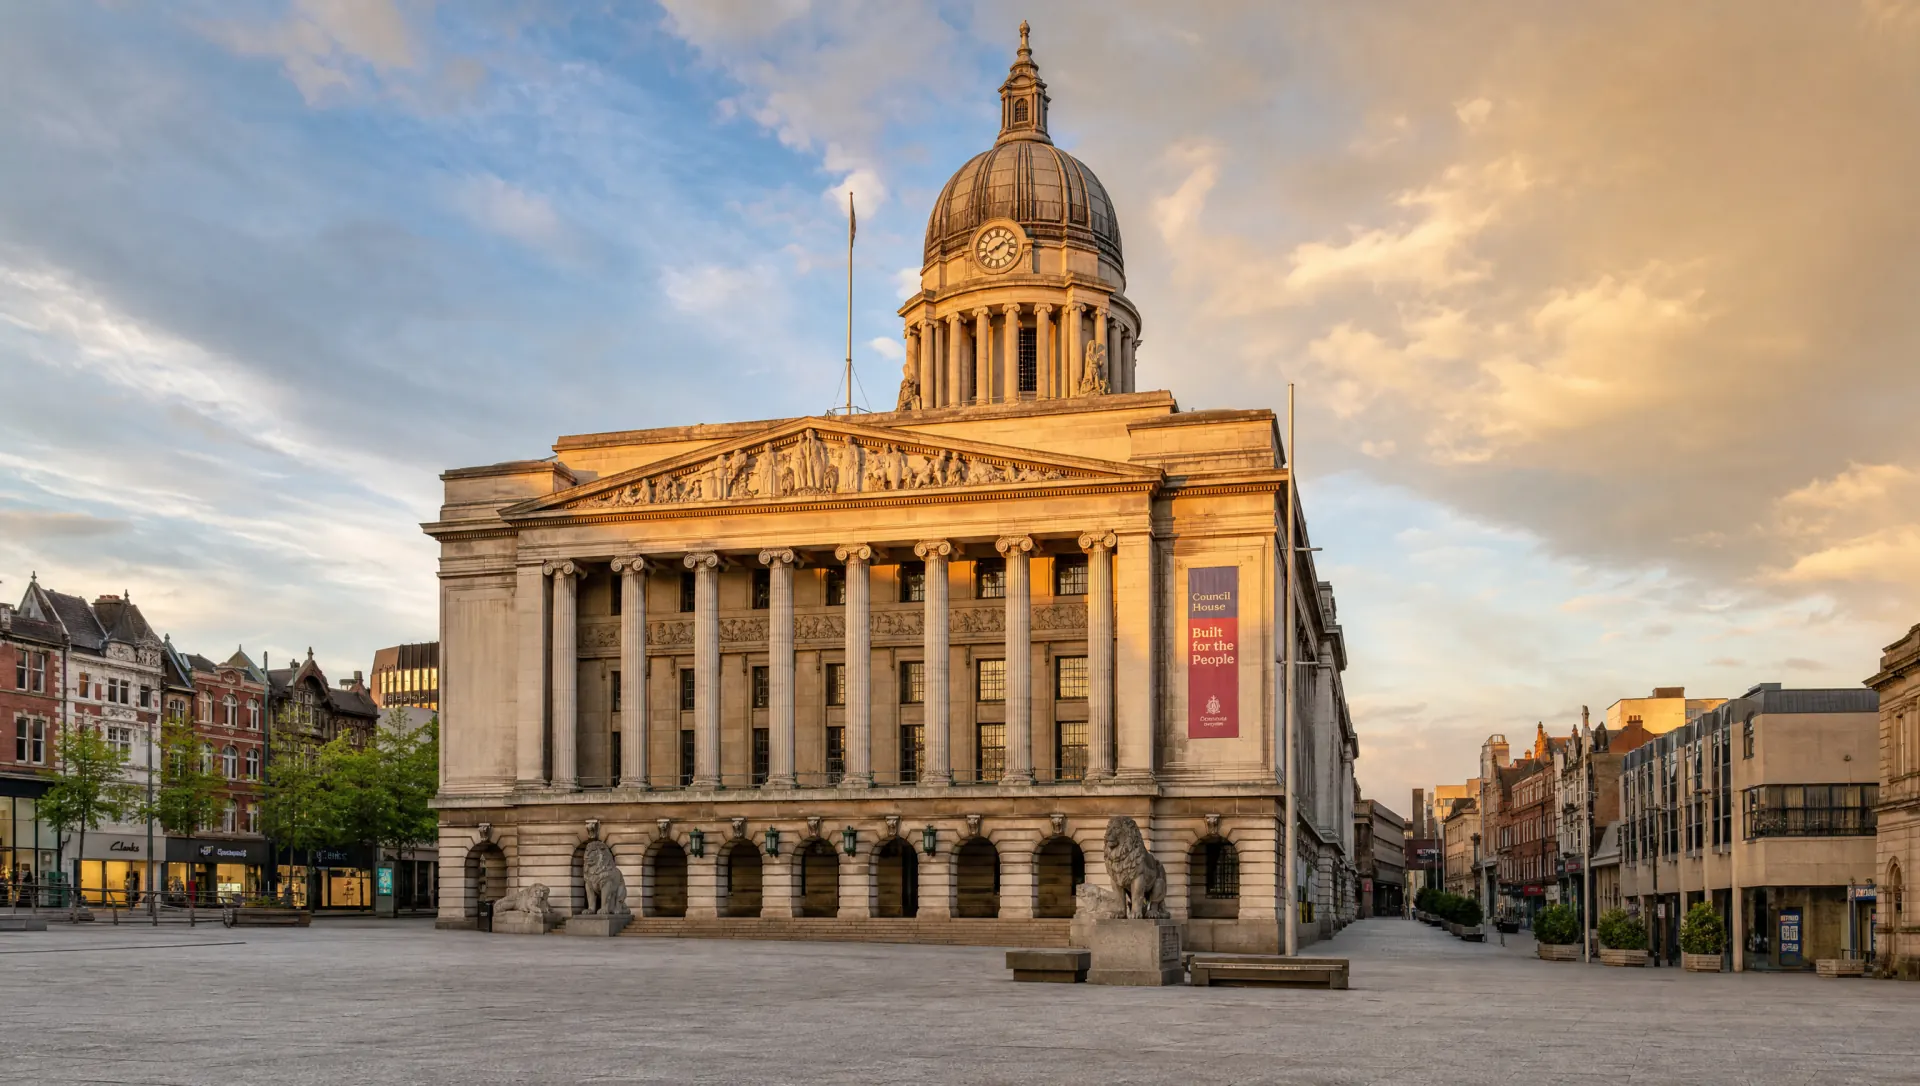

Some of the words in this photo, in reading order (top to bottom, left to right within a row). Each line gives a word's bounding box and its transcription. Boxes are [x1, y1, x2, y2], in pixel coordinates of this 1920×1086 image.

[1192, 592, 1231, 602] Council
[1193, 603, 1226, 612] House
[1192, 626, 1223, 638] Built
[1192, 641, 1211, 652] for
[1213, 640, 1234, 651] the
[1192, 653, 1234, 667] People
